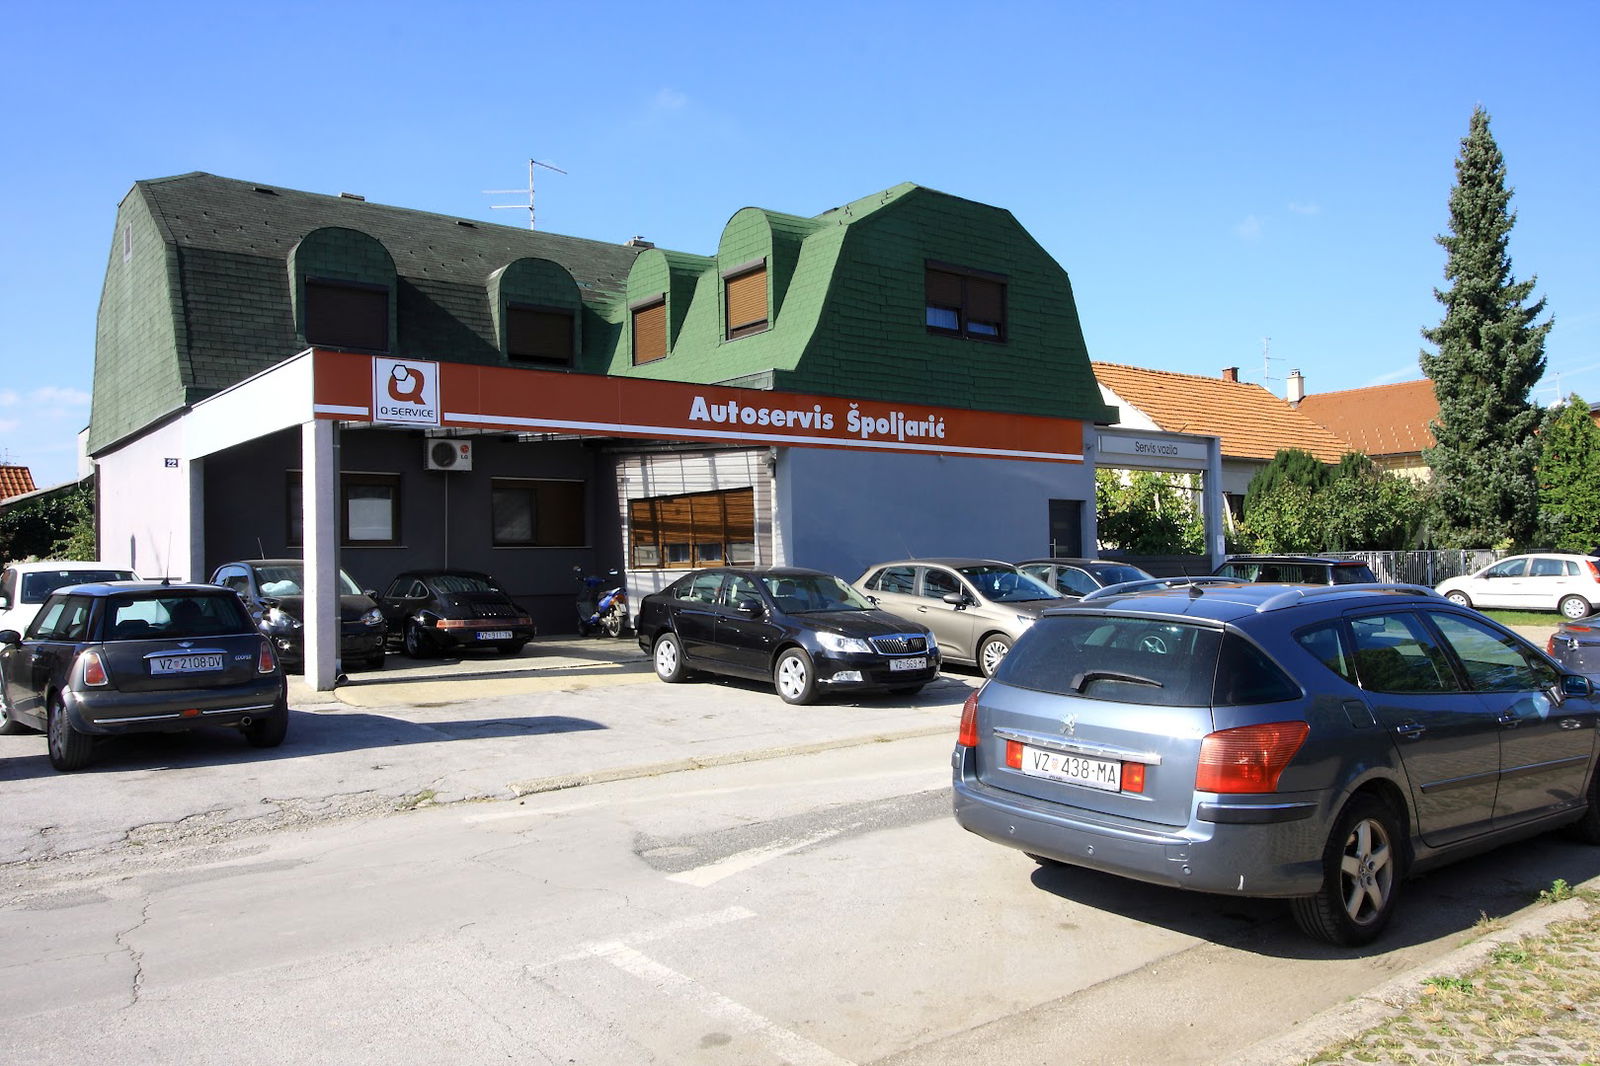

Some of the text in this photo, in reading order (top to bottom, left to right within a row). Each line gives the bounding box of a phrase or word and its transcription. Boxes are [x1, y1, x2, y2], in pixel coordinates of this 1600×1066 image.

[689, 396, 945, 441] Autoservis Špoljarić
[1135, 441, 1178, 455] Servis vozila
[160, 659, 174, 670] VZ
[1033, 751, 1050, 772] VZ
